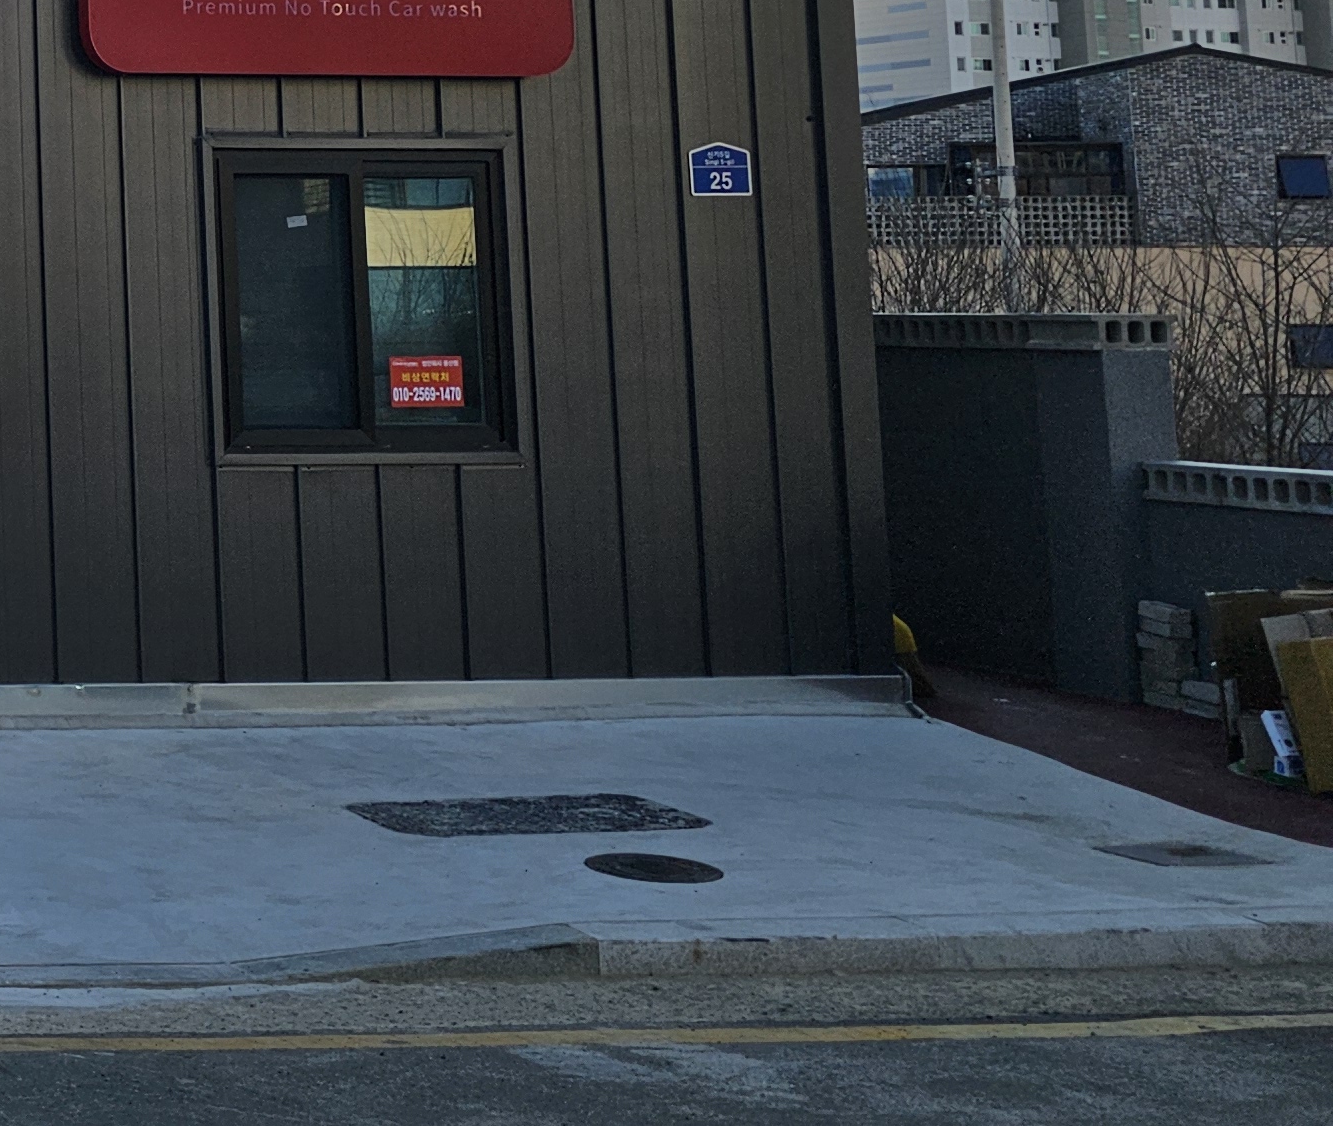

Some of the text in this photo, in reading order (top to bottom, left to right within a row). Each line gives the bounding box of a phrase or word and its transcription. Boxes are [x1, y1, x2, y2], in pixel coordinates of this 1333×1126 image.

[285, 0, 312, 17] No
[319, 0, 382, 18] Touch
[388, 0, 422, 18] Car
[430, 0, 483, 19] wash
[709, 171, 733, 190] 25
[402, 372, 450, 383] 비상연락처
[393, 387, 462, 402] 010-2569-1470
